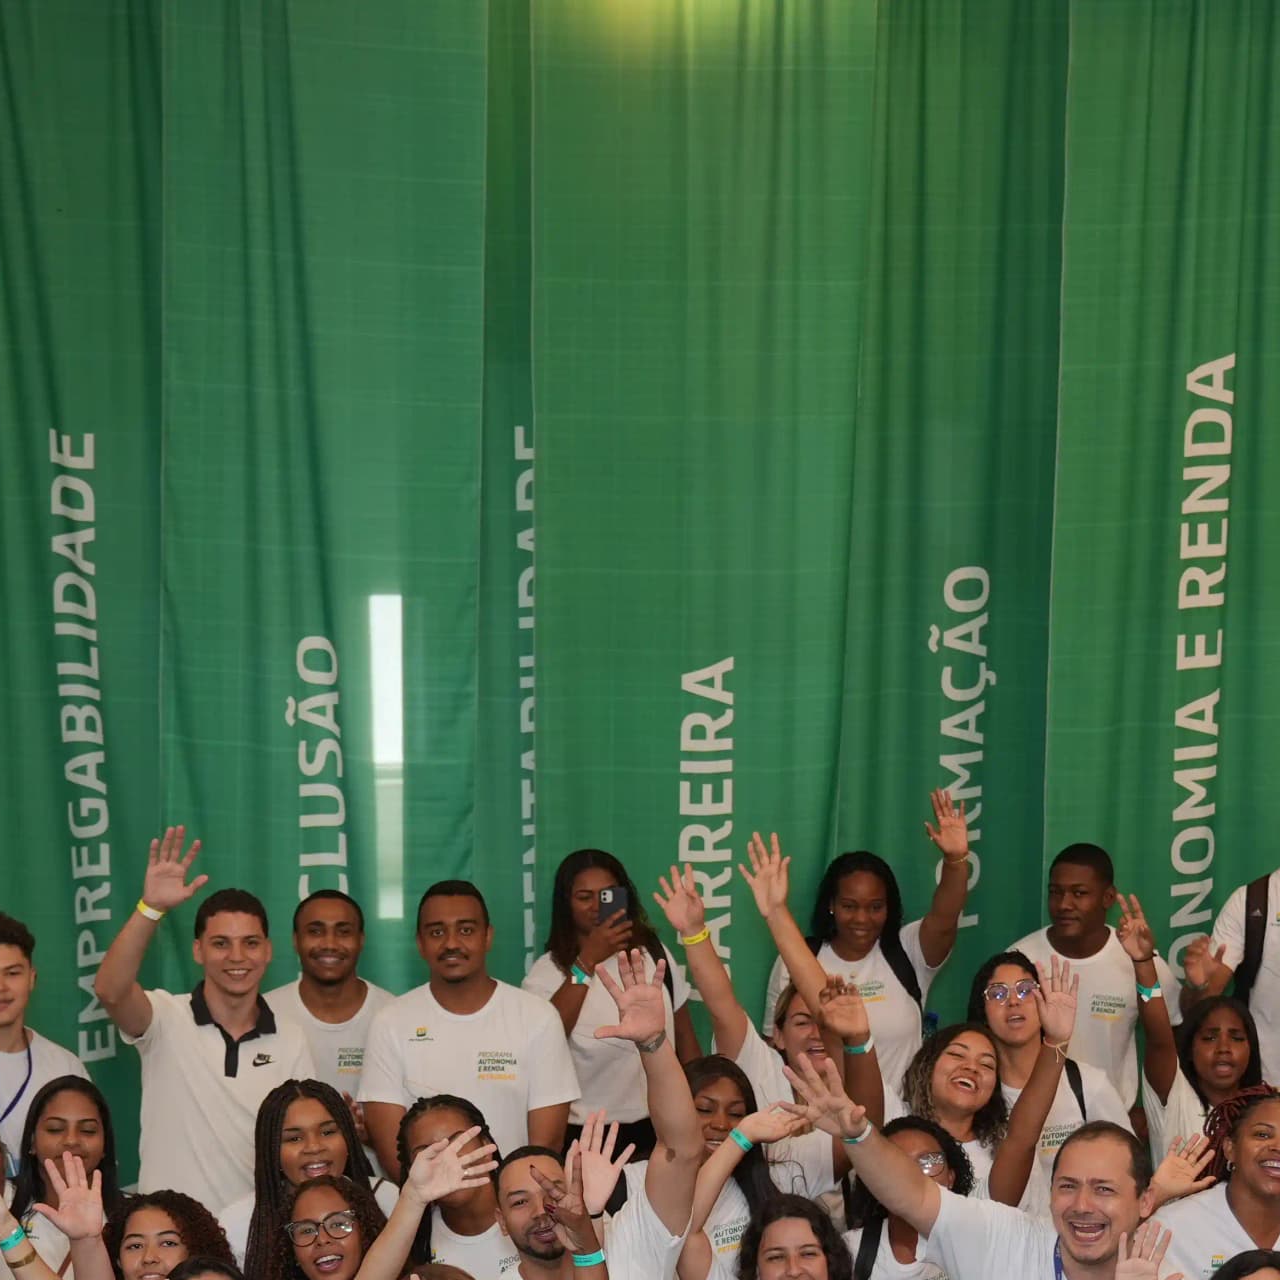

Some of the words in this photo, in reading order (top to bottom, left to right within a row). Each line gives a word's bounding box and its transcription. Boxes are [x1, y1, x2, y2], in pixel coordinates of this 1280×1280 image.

[1177, 353, 1236, 609] RENDA
[49, 428, 116, 1063] EMPREGABILIDADE
[285, 635, 348, 900] CLUSÃO
[1176, 629, 1222, 671] E
